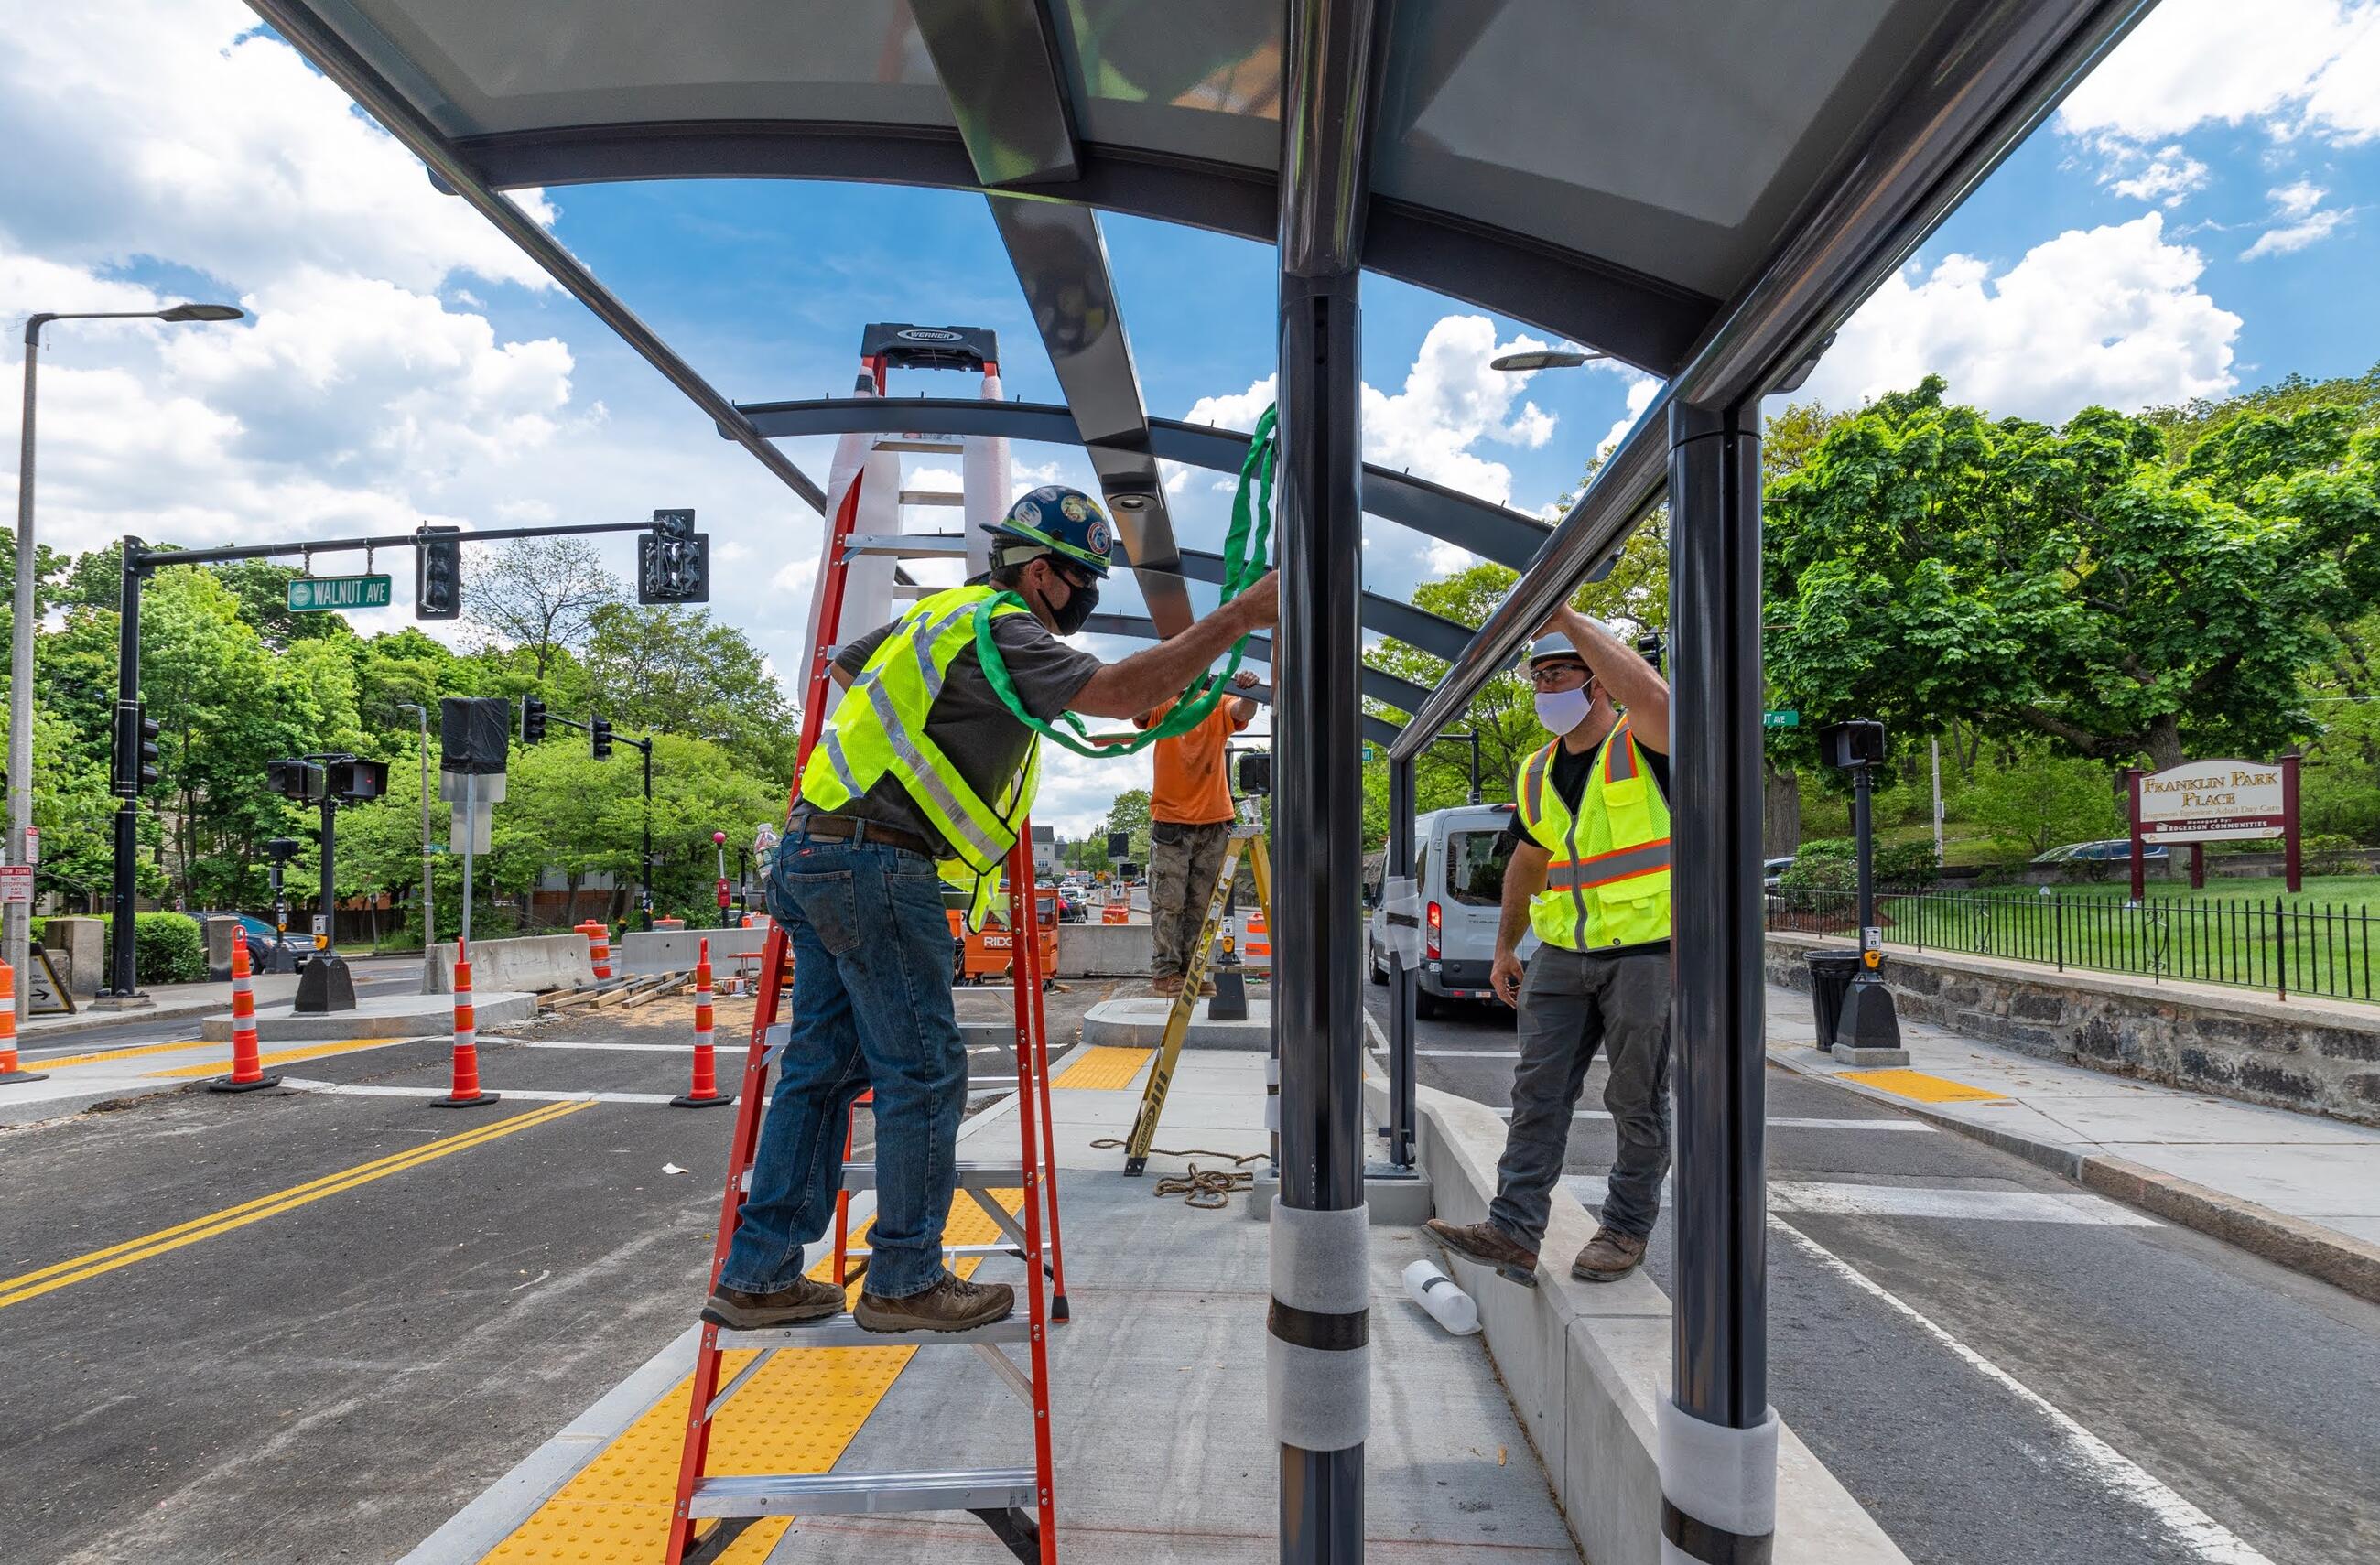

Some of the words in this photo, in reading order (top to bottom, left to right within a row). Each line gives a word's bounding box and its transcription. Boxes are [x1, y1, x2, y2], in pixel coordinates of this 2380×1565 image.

[314, 581, 362, 606] WALNUT
[366, 583, 386, 603] AVE
[1773, 715, 1786, 724] AVE
[2143, 777, 2225, 793] FRANKLIN
[2231, 772, 2278, 786] PARK
[2182, 792, 2235, 807] PLACE
[2211, 821, 2267, 829] COMMUNITIES
[1138, 1113, 1154, 1149] WERNER
